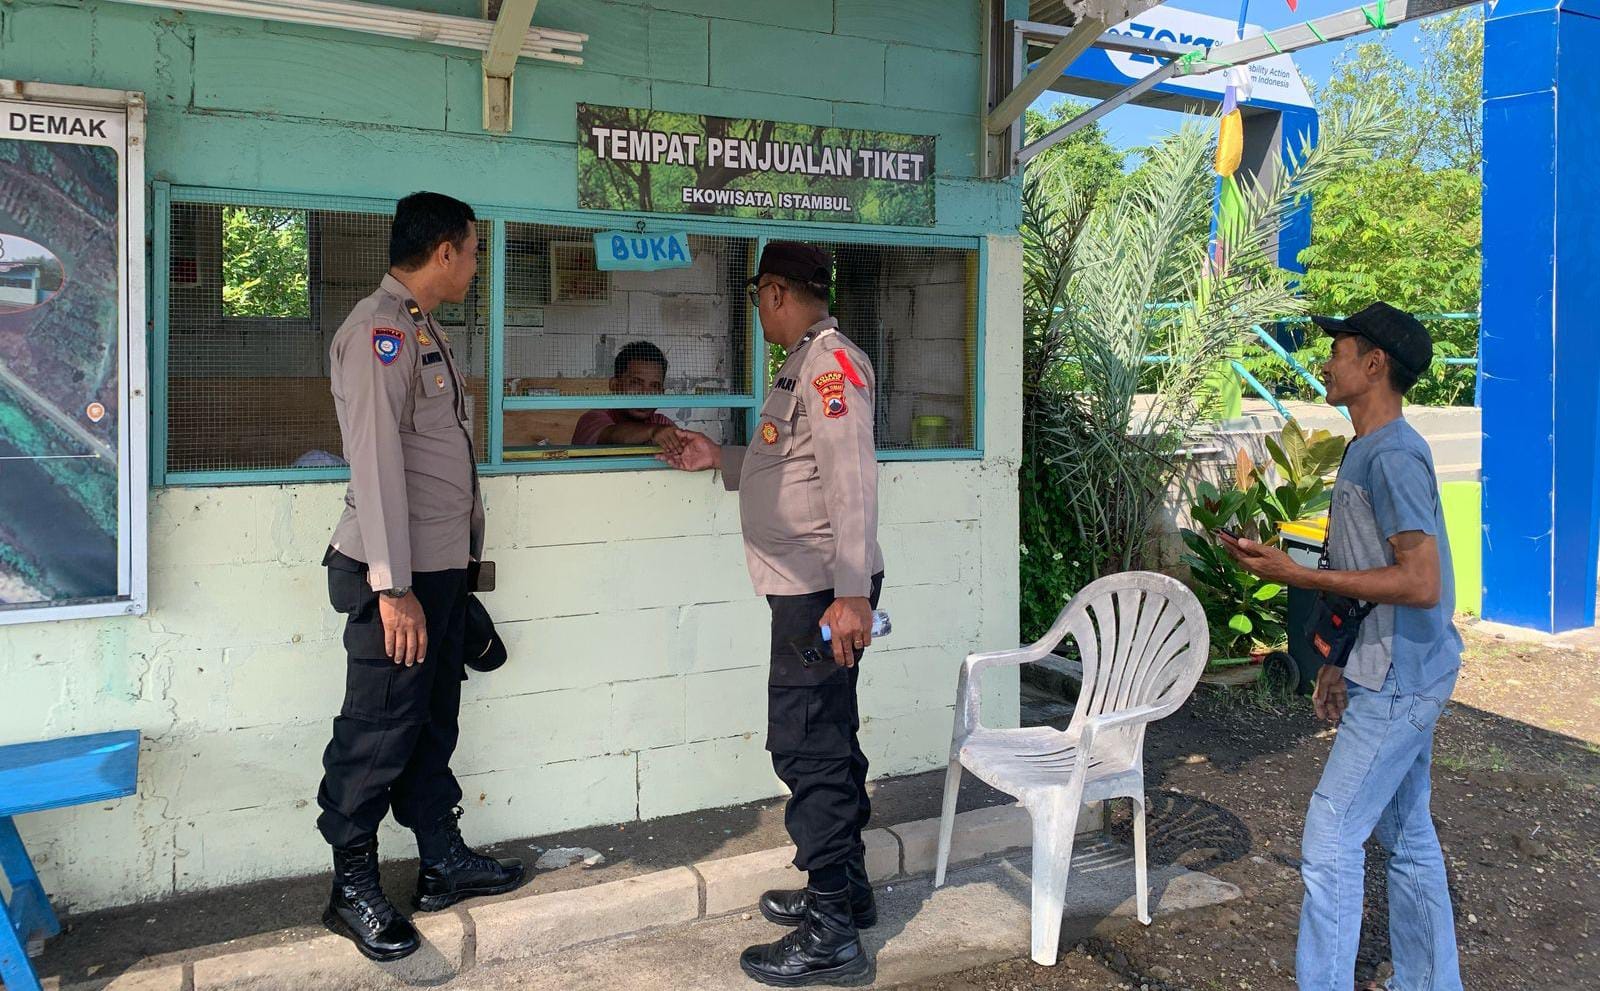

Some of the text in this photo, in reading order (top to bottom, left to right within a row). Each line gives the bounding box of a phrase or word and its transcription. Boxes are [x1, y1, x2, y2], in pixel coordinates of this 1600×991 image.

[1258, 76, 1289, 88] Indonesia
[1269, 68, 1290, 78] Action
[9, 112, 107, 138] DEMAK
[592, 127, 924, 181] TEMPAT PENJUALAN TIKET
[682, 187, 851, 211] EKOWISATA ISTAMBUL
[611, 235, 686, 262] BUKA
